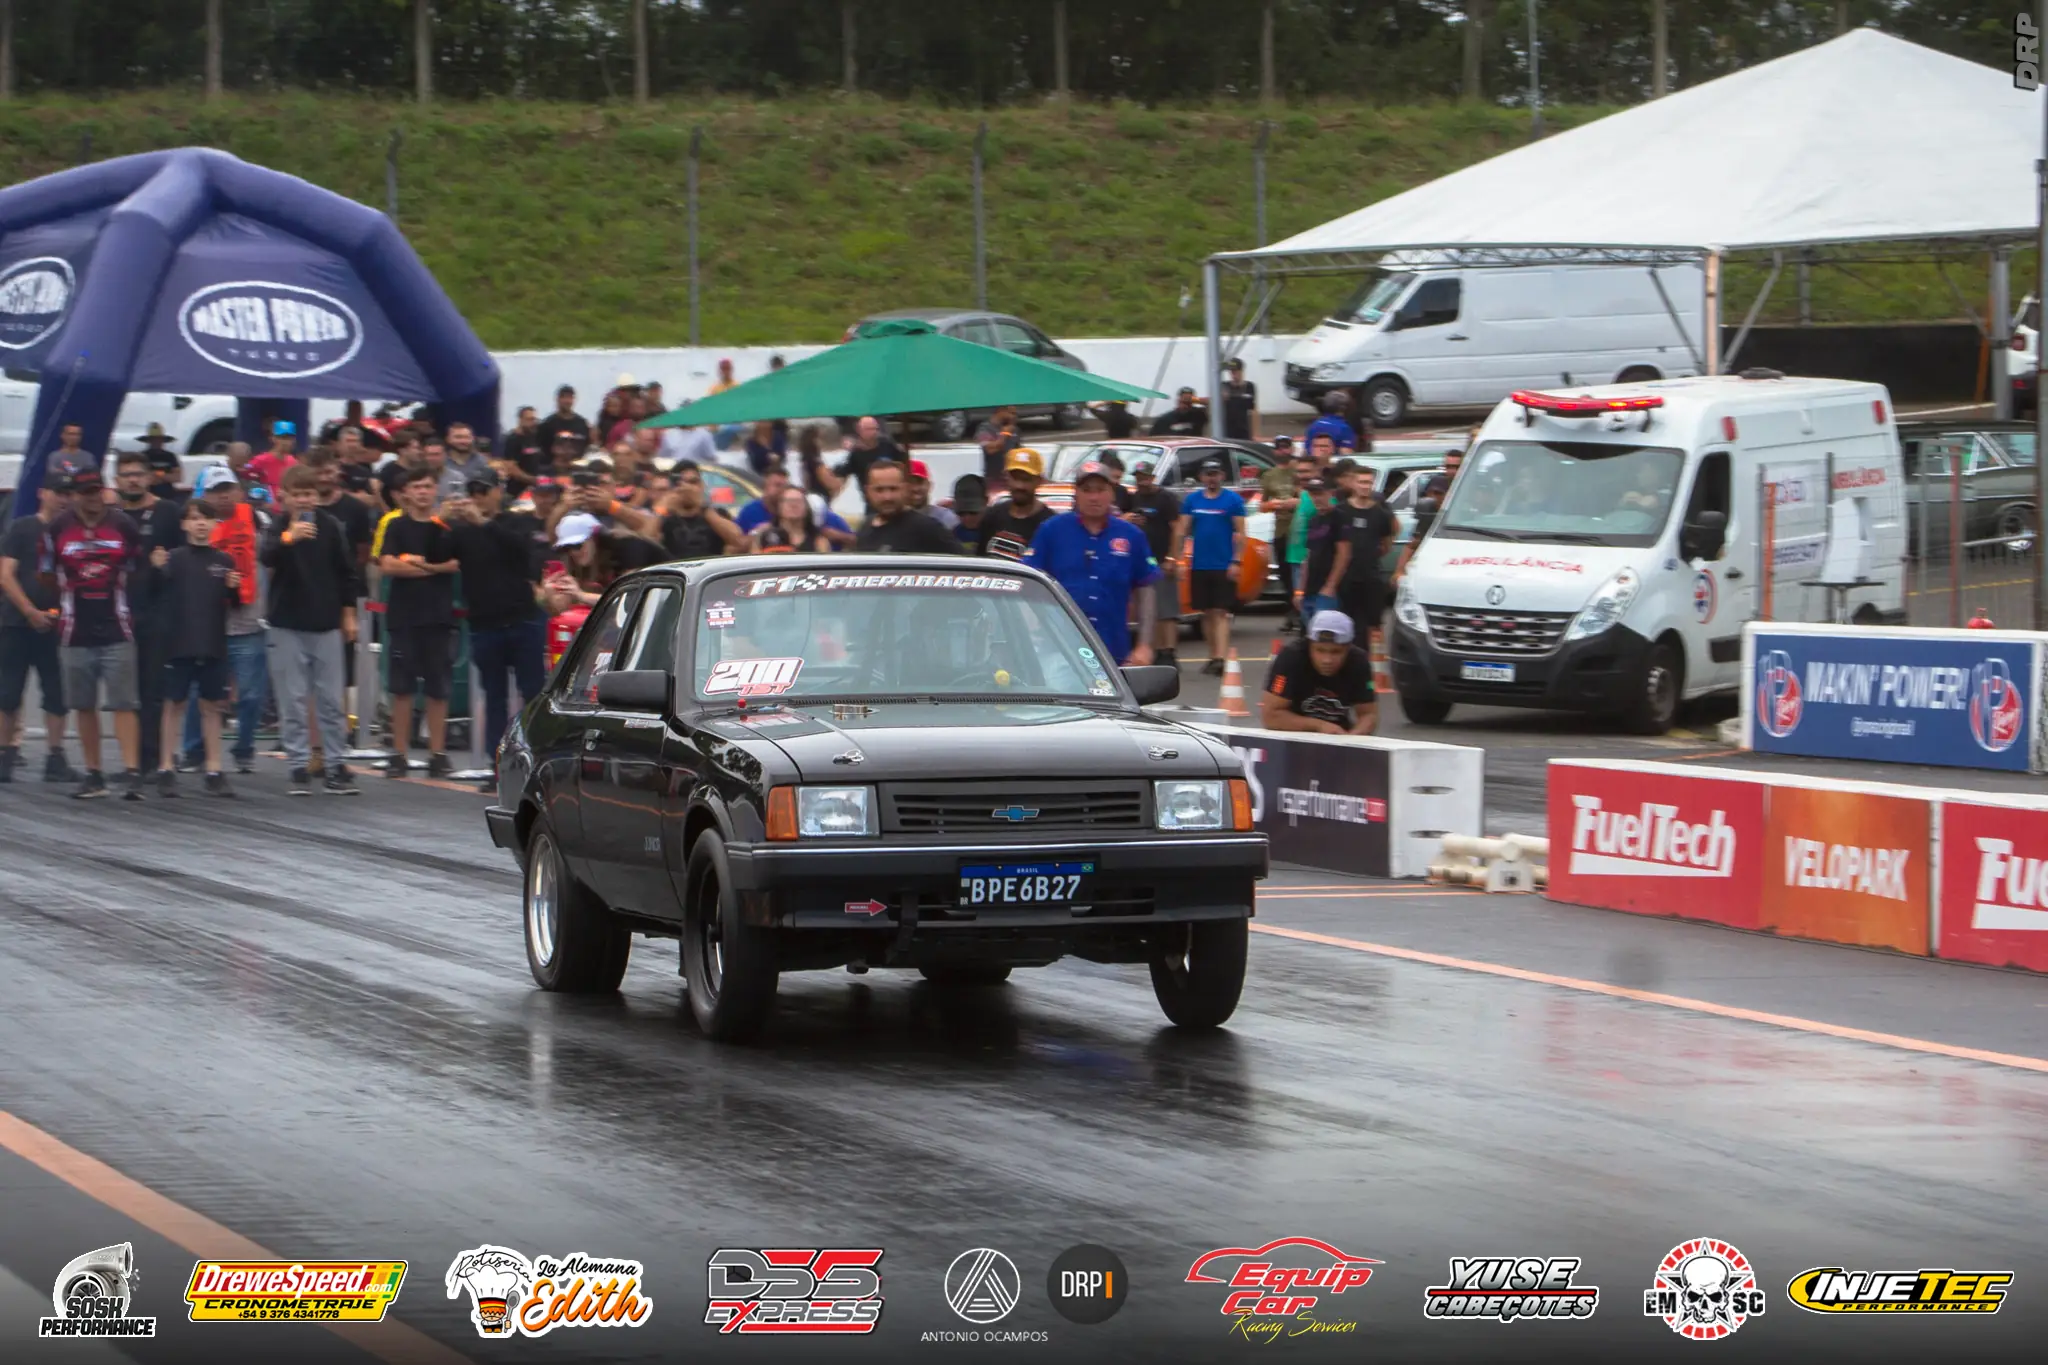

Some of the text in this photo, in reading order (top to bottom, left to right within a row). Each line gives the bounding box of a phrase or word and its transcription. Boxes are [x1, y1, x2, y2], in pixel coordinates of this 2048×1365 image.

[192, 297, 348, 343] MASTER POWER
[749, 574, 1023, 596] F1 PREPARAÇÕES
[705, 659, 801, 693] 200
[1805, 661, 1970, 710] MAKIN' POWER!
[1571, 794, 1736, 877] FuelTech
[971, 875, 1081, 903] BPE6B27
[1784, 836, 1911, 902] VELOPARK
